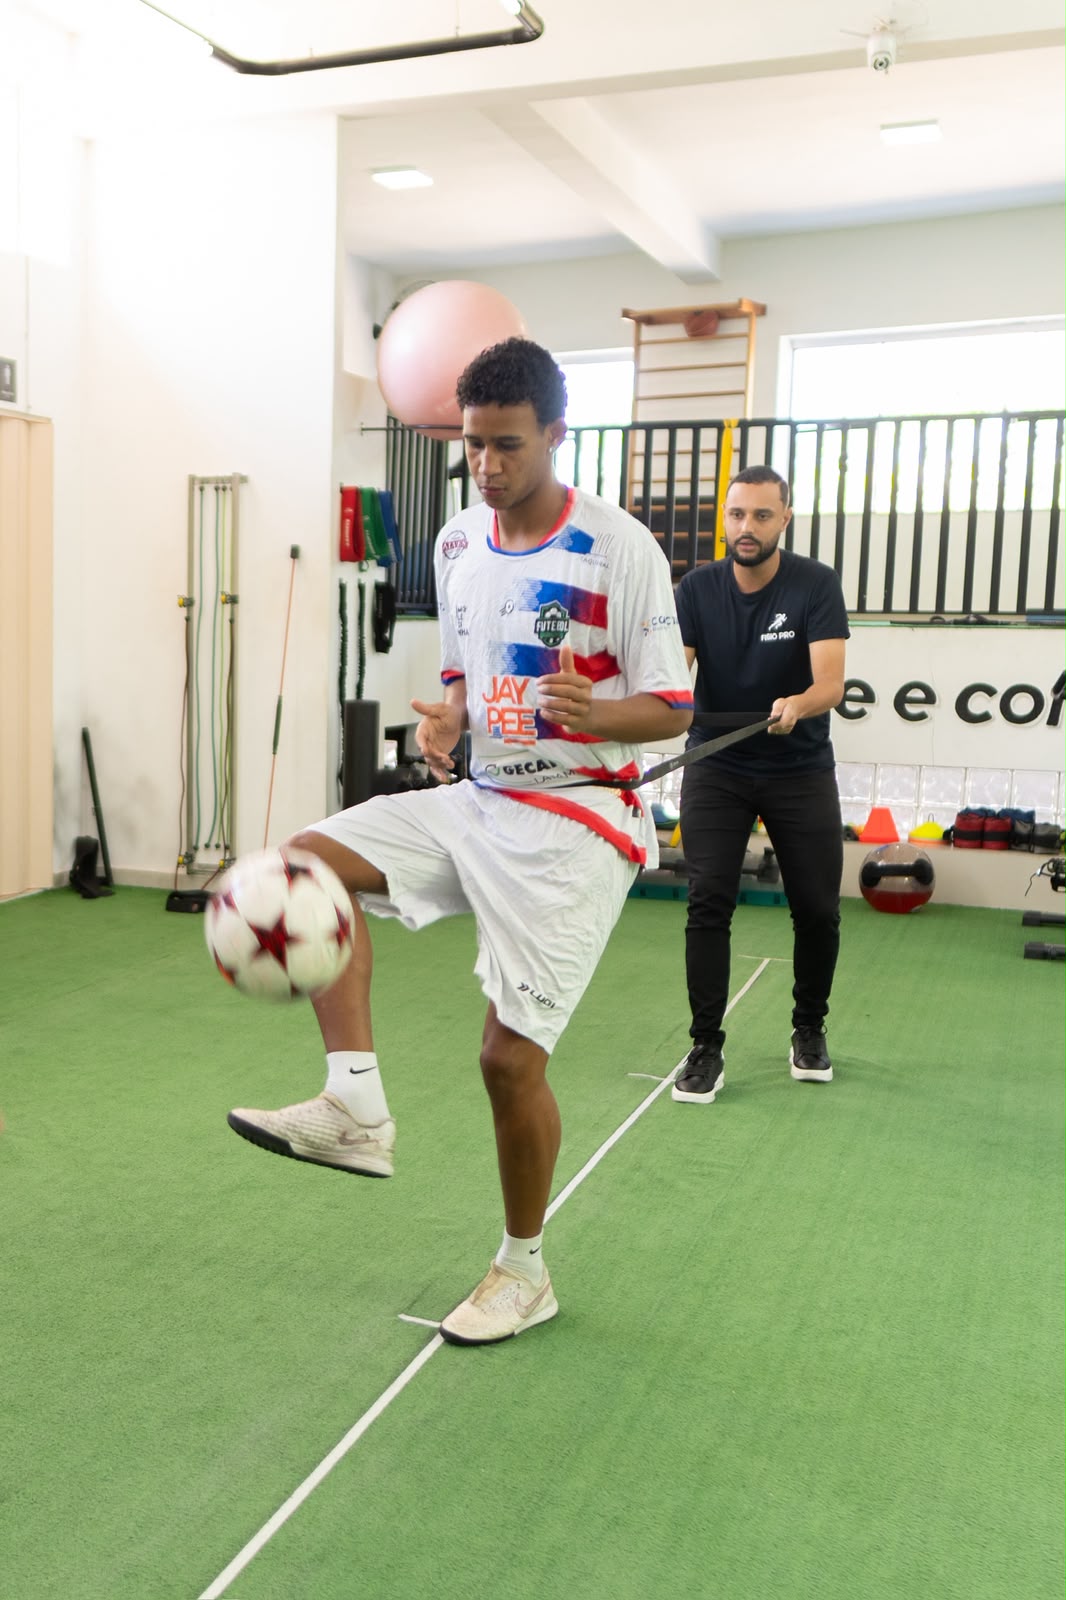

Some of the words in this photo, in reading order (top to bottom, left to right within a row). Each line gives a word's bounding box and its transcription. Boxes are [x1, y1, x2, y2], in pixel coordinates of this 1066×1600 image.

[536, 619, 569, 632] FUTEBOL
[778, 630, 795, 640] PRO
[482, 676, 530, 705] JAY
[893, 680, 937, 722] e
[487, 705, 536, 736] PEE
